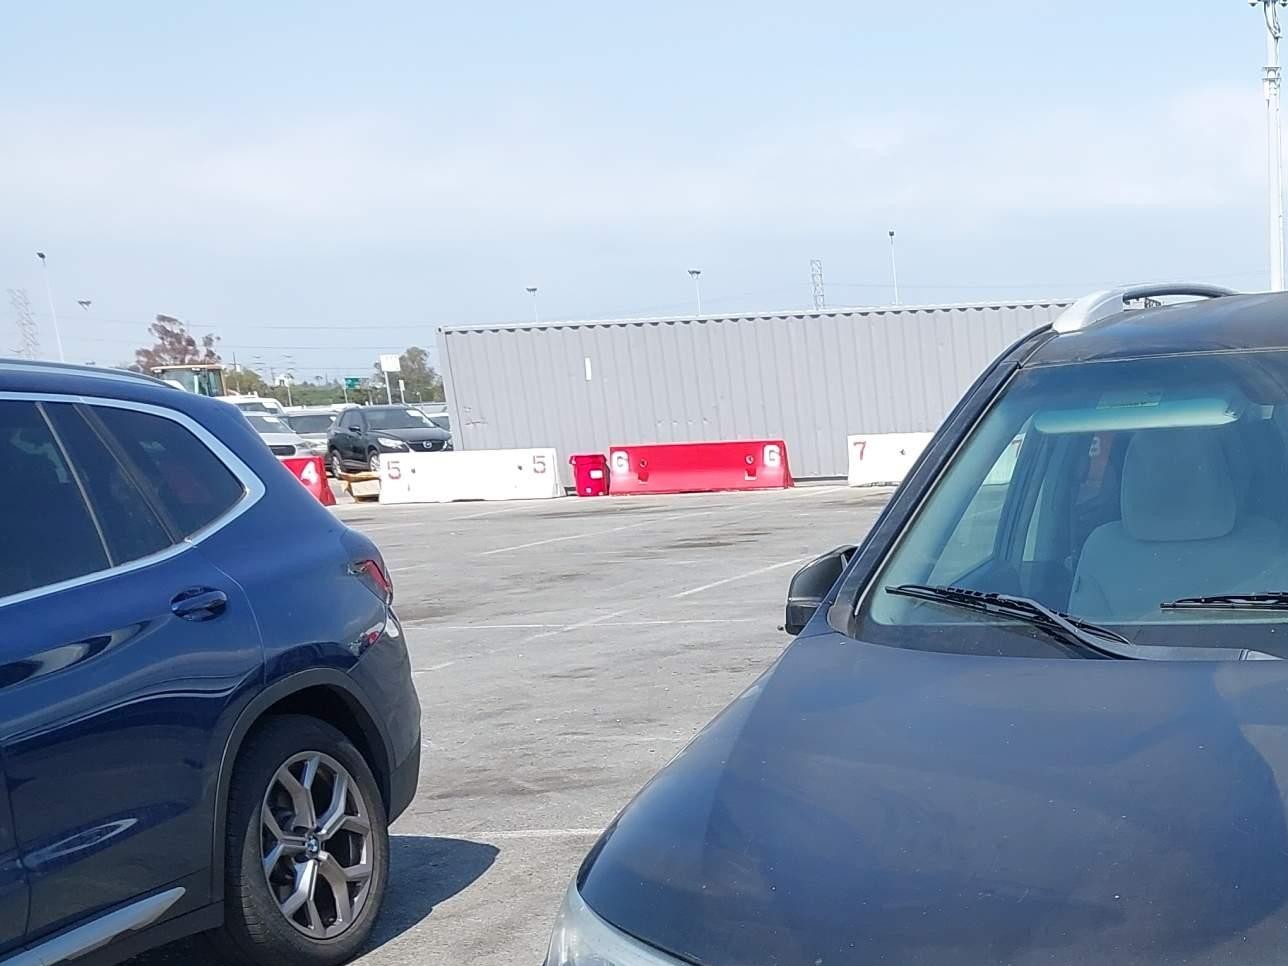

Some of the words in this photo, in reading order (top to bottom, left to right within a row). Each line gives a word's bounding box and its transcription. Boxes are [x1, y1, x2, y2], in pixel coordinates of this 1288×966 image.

[852, 441, 867, 461] 7
[387, 460, 402, 480] 5
[532, 455, 547, 474] 5
